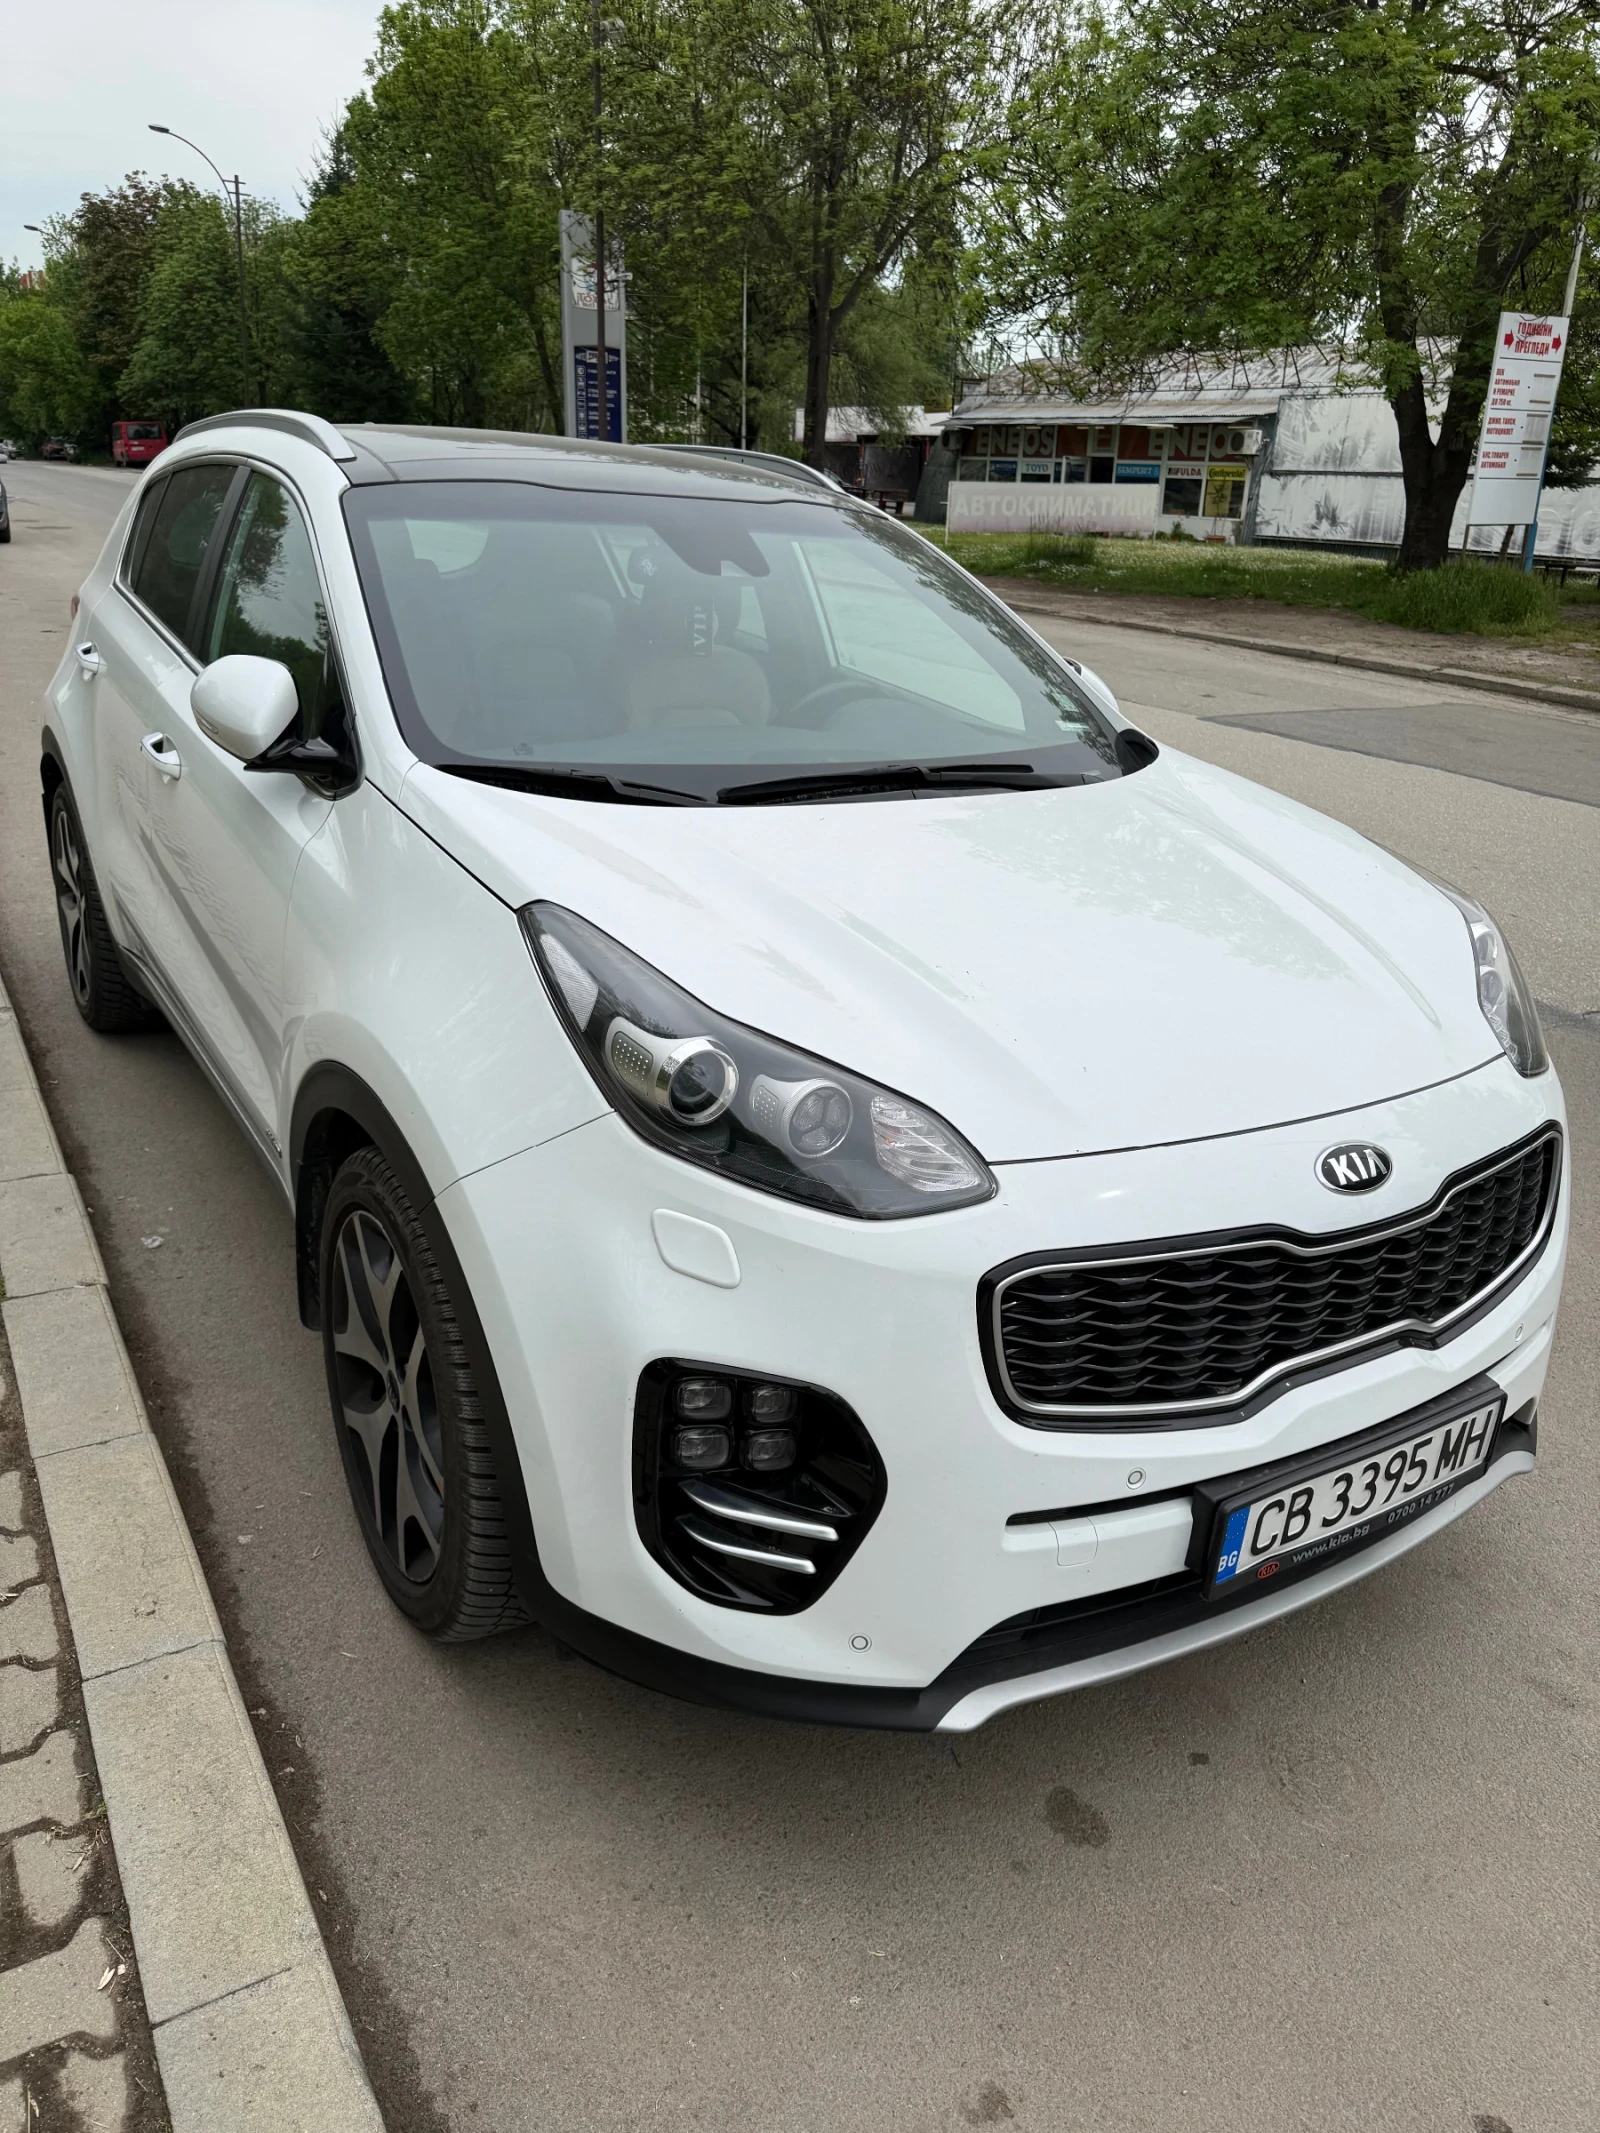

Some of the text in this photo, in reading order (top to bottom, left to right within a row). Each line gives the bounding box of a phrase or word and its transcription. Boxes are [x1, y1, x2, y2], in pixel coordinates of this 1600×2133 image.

[1517, 322, 1553, 337] ГОДИШНИ
[1514, 340, 1550, 356] ПРЕГЛЕДИ
[976, 426, 1053, 456] ENEOS
[1148, 425, 1231, 458] ENEO
[1025, 463, 1049, 473] TOYO
[1176, 467, 1202, 477] FULDA
[953, 495, 1156, 518] АВТОКЛИМАТИЦИ
[1327, 1148, 1388, 1186] KIA
[1321, 1436, 1434, 1528] 3395
[1291, 1482, 1455, 1564] www.kia.bg 0700 14 777
[1218, 1550, 1239, 1573] BG
[1260, 1563, 1277, 1578] KIA
